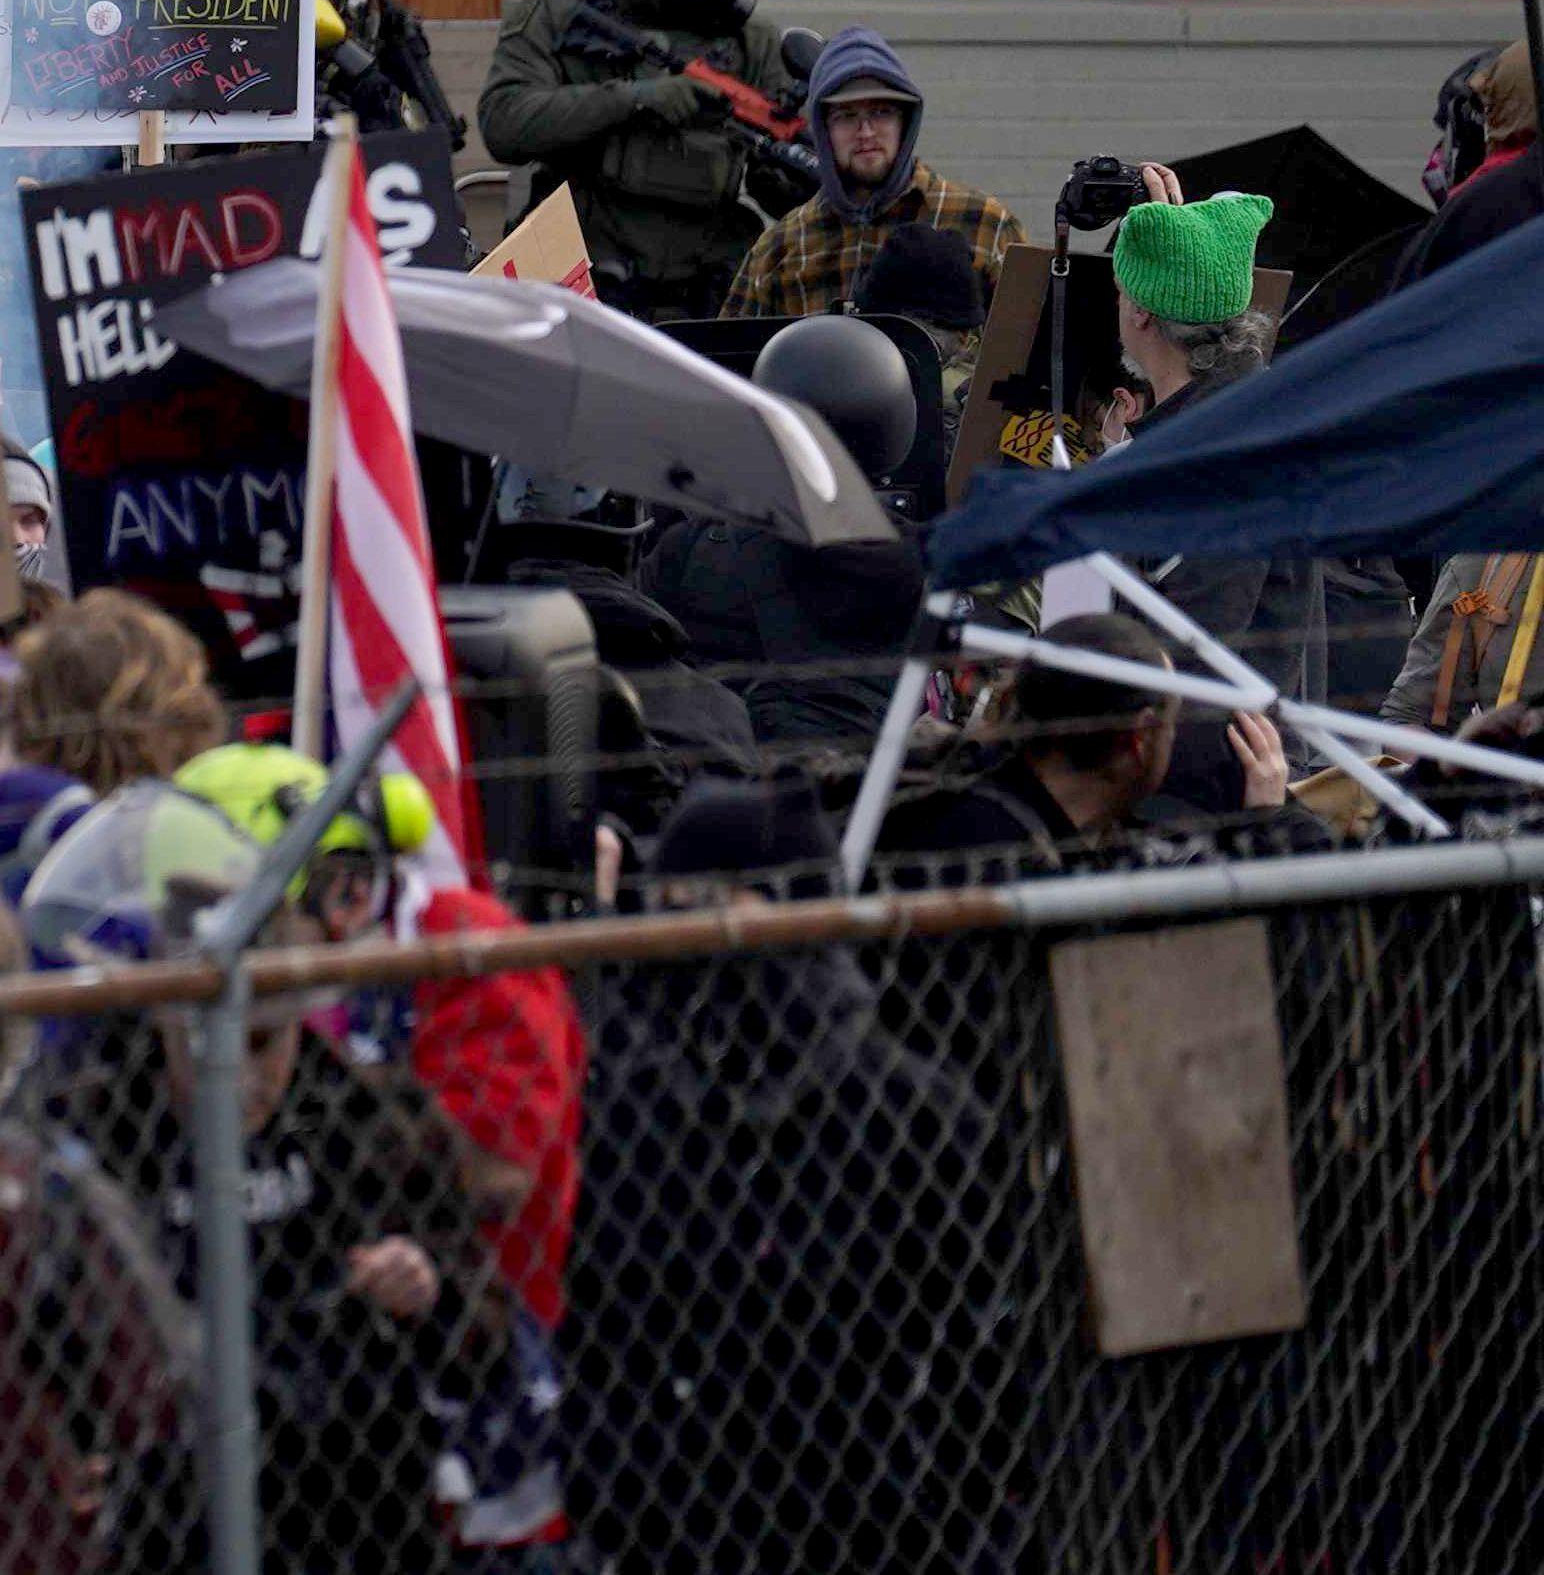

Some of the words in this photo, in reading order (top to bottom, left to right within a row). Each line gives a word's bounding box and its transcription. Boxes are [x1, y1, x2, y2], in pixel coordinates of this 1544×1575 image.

[22, 26, 135, 95] LIBERTY
[98, 68, 131, 90] AND
[130, 31, 214, 80] JUSTICE
[170, 58, 211, 89] FOR
[215, 57, 263, 94] ALL
[37, 206, 122, 300] I'M
[116, 191, 283, 278] MAD
[107, 469, 307, 562] ANYM
